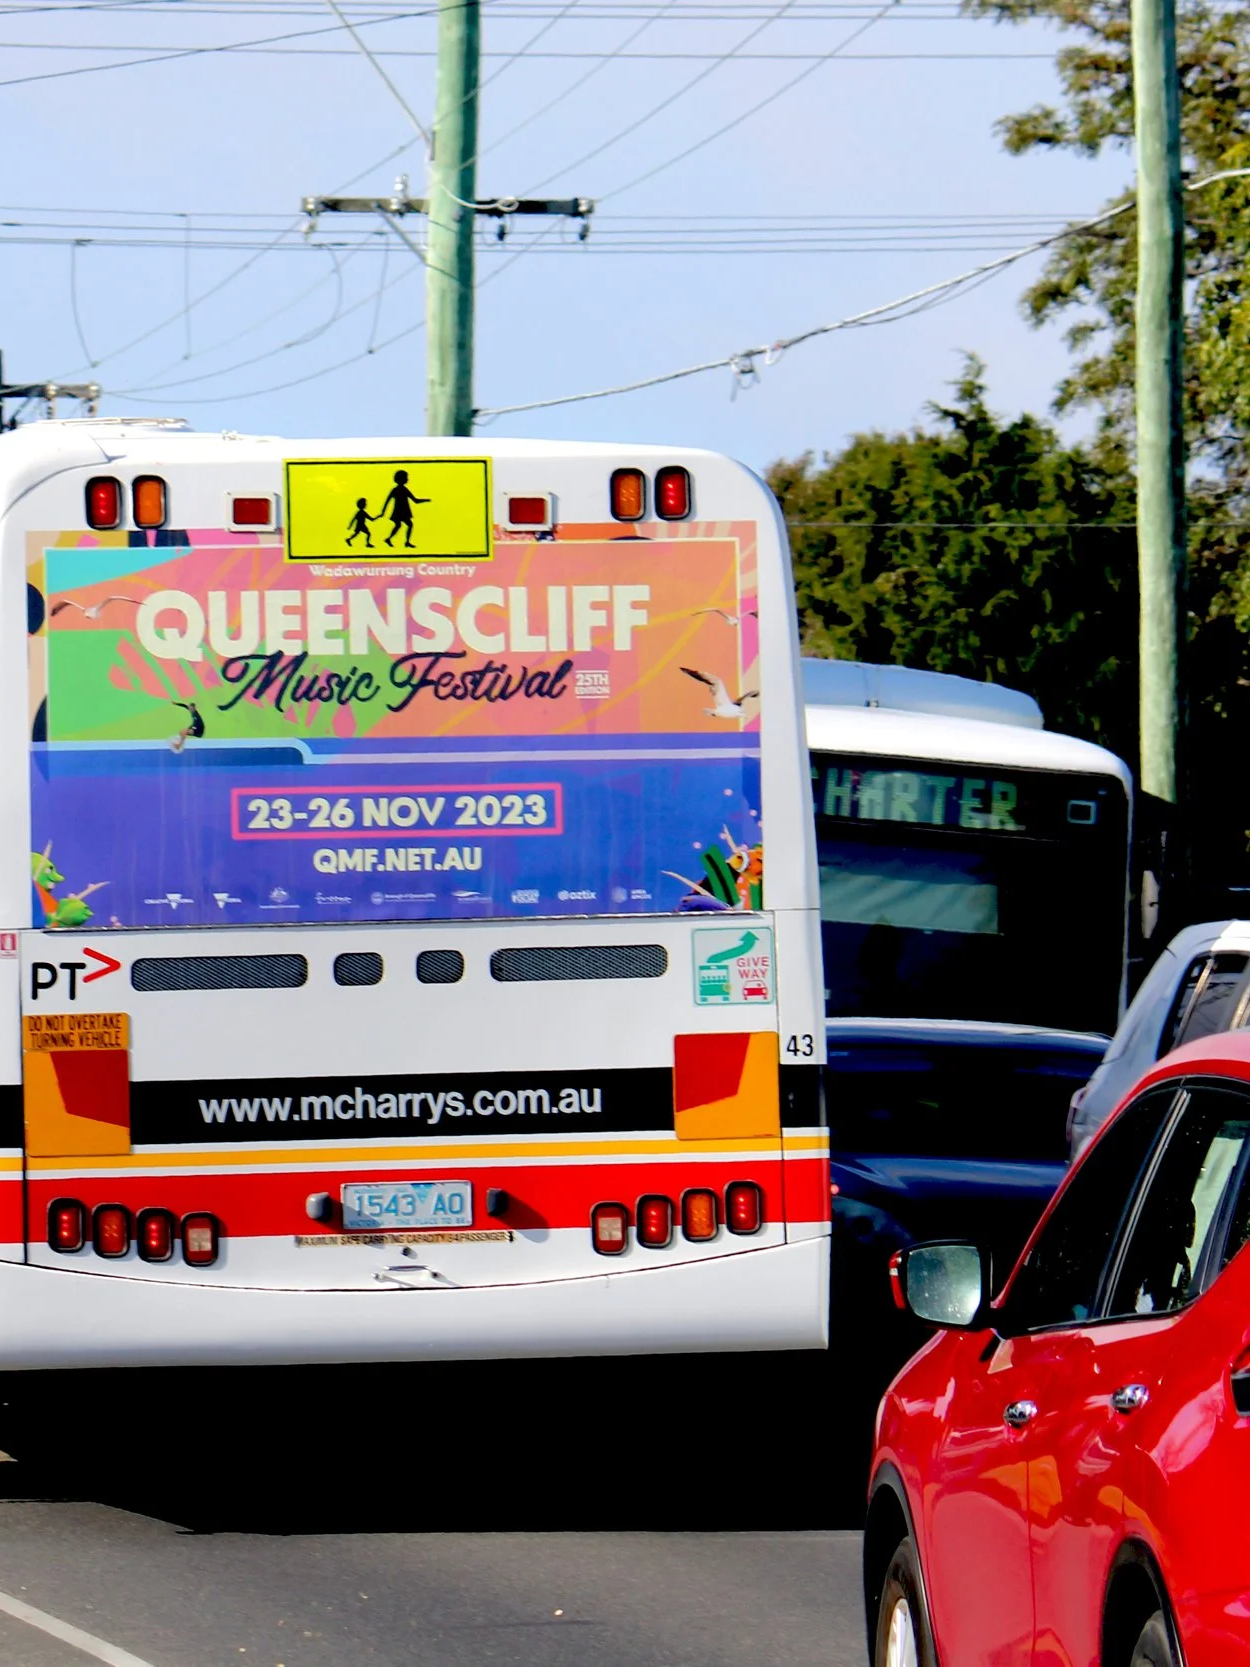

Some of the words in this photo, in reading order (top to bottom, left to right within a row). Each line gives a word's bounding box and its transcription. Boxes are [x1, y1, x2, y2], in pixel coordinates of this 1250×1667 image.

[309, 564, 415, 579] Wadawurrung
[417, 563, 476, 578] Country
[135, 585, 651, 662] QUEENSCLIFF
[218, 650, 380, 713] Music
[386, 651, 574, 713] Festival
[576, 672, 610, 686] 25TH
[248, 797, 355, 829] 23-26
[362, 796, 446, 827] NOV
[454, 794, 548, 826] 2023
[312, 847, 482, 874] QMF.NET.AU
[736, 956, 770, 968] GIVE
[738, 968, 768, 979] WAY
[29, 1015, 42, 1031] DO
[45, 1015, 65, 1031] NOT
[69, 1014, 122, 1031] OVERTAKE
[30, 1032, 75, 1049] TURNING
[78, 1031, 122, 1048] VEHICLE
[786, 1034, 814, 1057] 43
[198, 1086, 602, 1125] www.mcharrys.com.au
[355, 1192, 416, 1217] 1543
